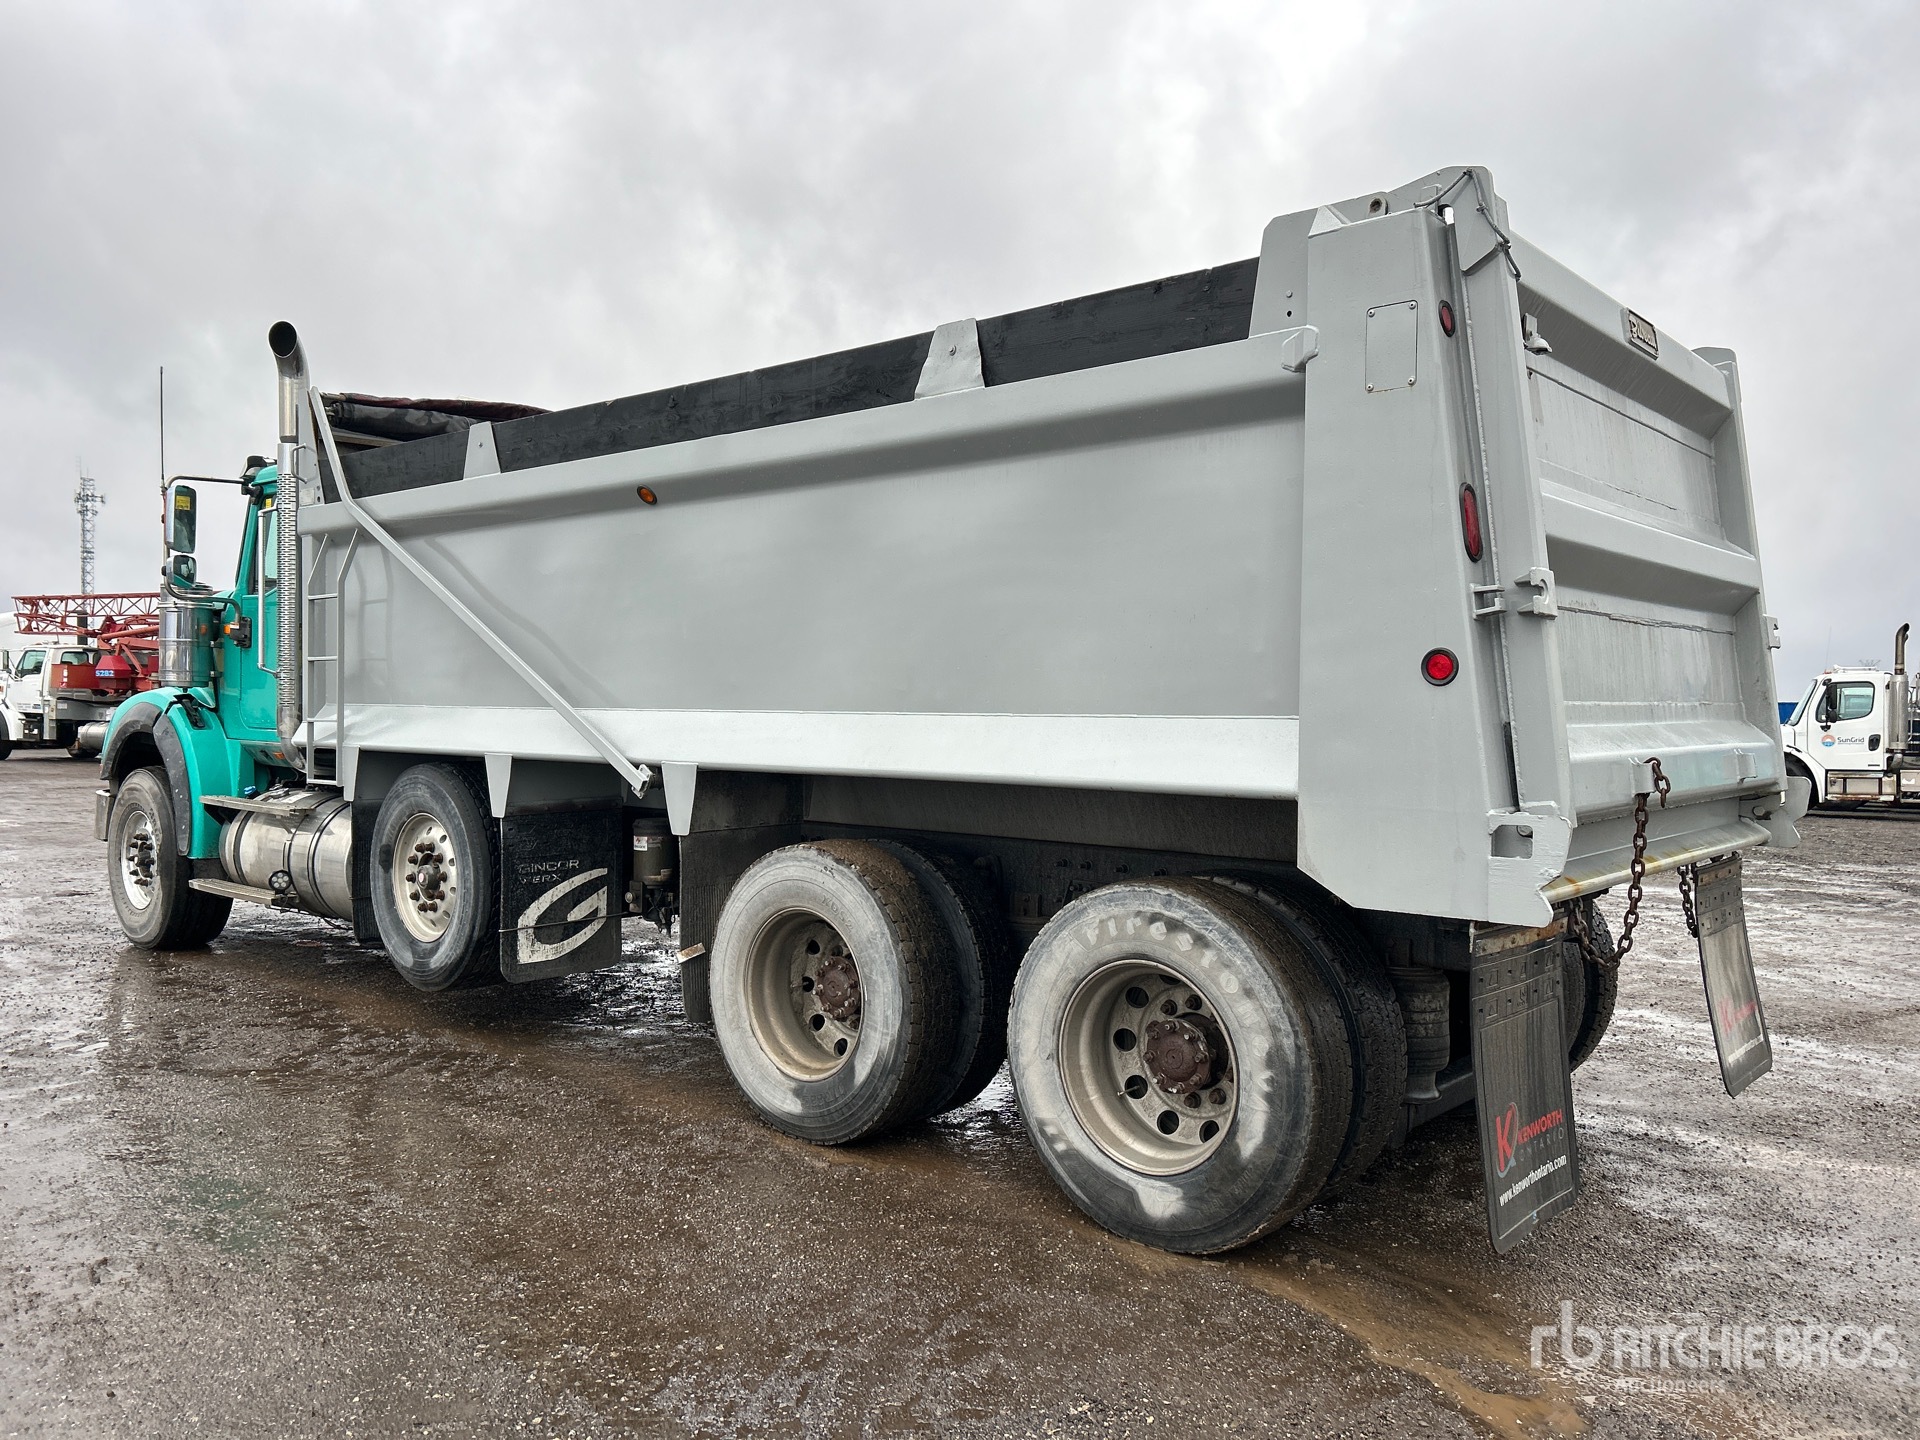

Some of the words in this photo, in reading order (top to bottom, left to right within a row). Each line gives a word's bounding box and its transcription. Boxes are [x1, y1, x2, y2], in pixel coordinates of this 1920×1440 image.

[518, 859, 580, 874] GINCOR
[1083, 917, 1270, 1058] Firestone
[1518, 1108, 1563, 1145] KENWORTH
[1520, 1127, 1565, 1162] ONTARIO
[1499, 1154, 1567, 1207] www.kenworthontario.com
